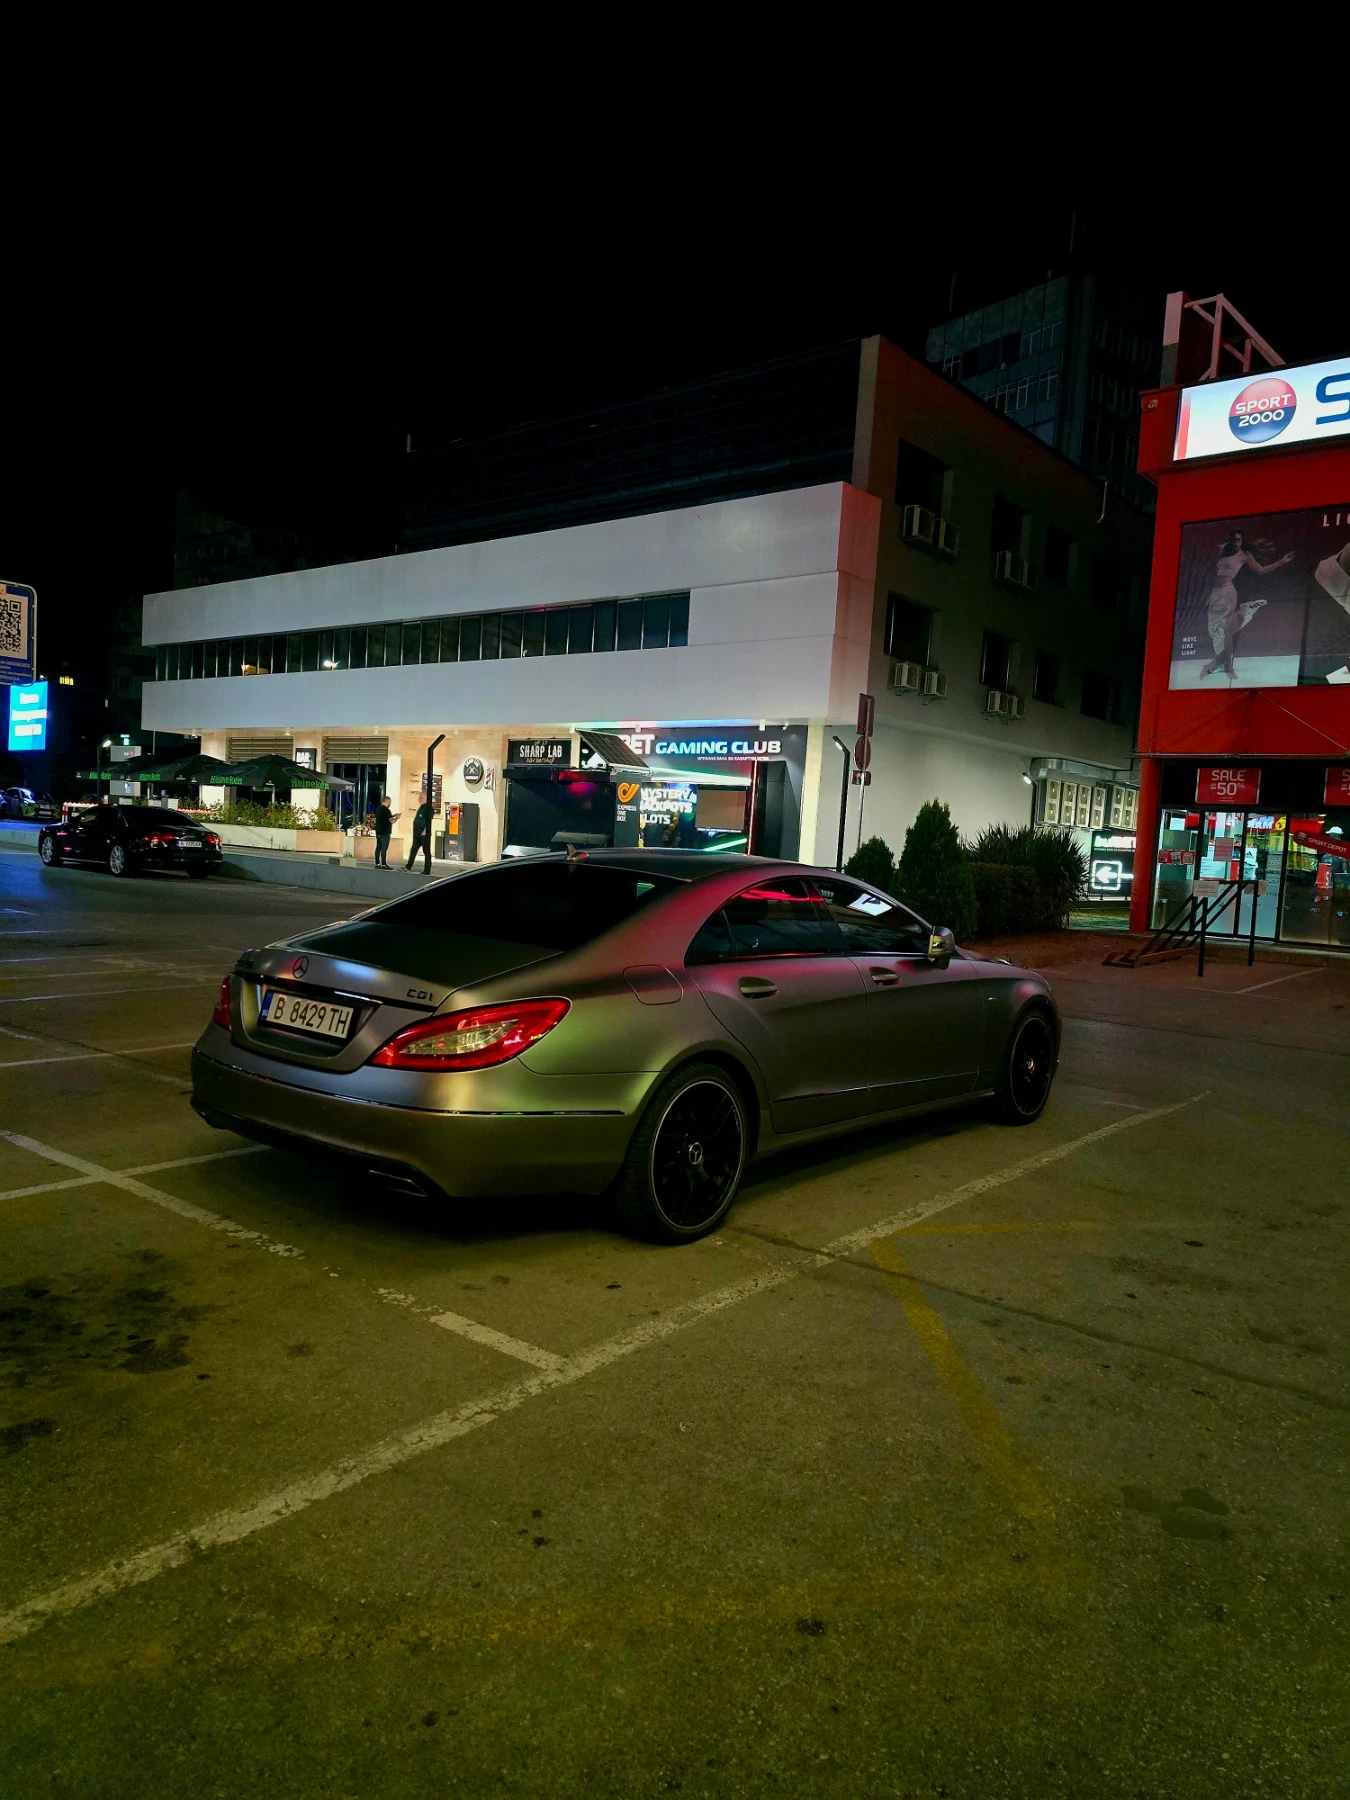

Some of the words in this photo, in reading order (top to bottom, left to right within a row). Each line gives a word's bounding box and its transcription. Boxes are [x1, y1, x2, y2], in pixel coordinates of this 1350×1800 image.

[1235, 394, 1292, 414] SPORT
[1238, 409, 1285, 427] 2000
[519, 744, 545, 757] SHARP
[547, 744, 563, 757] LAB
[655, 742, 728, 754] GAMING
[731, 741, 781, 753] CLUB
[210, 775, 243, 785] Heineken
[1211, 769, 1246, 781] SALE
[290, 778, 330, 789] Heineken
[641, 788, 691, 799] MYSTERY
[640, 800, 693, 813] JACKPOTS
[1308, 837, 1328, 847] SPORT
[1327, 843, 1347, 853] DEPOT
[406, 989, 433, 1002] CDI
[273, 997, 285, 1020] B
[290, 1001, 327, 1029] 8429
[328, 1008, 350, 1034] TH
